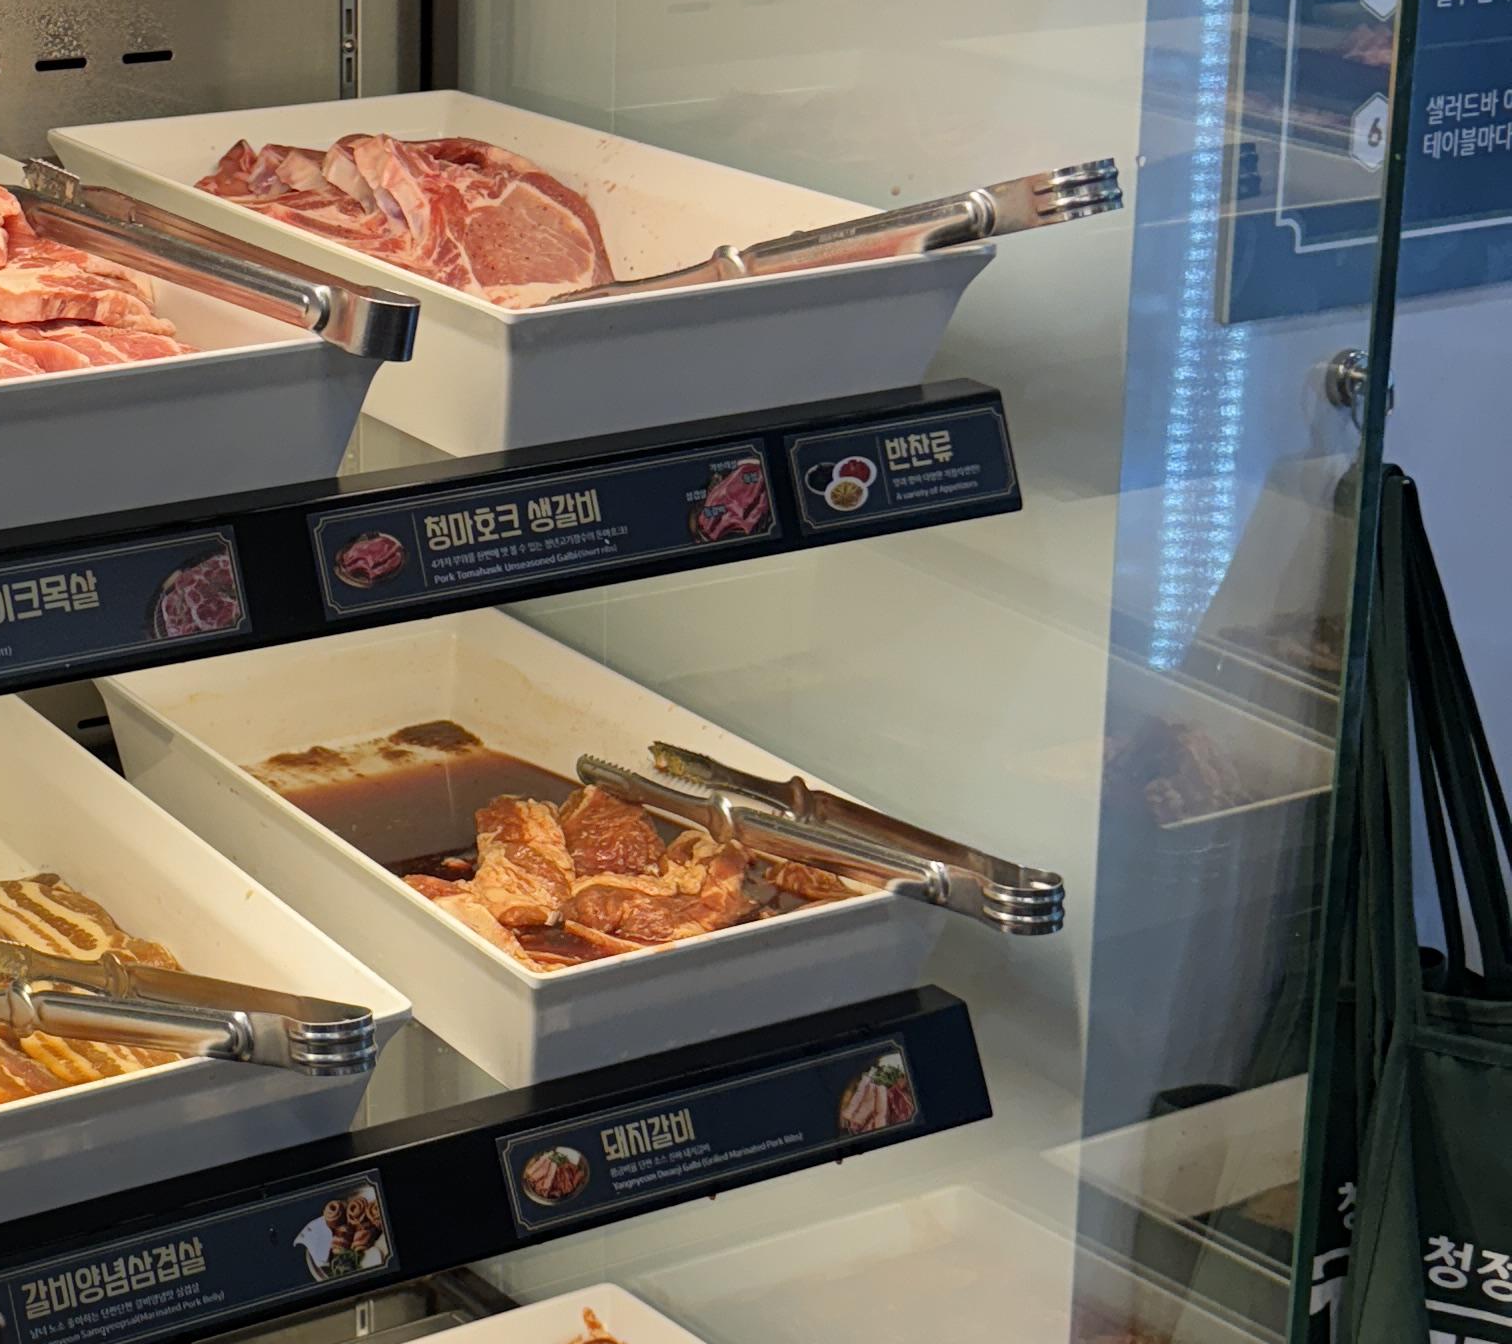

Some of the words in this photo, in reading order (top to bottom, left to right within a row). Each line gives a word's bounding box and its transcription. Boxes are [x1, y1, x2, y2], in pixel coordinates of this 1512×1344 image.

[1426, 90, 1498, 125] 샐러드바
[1368, 118, 1383, 147] 6
[885, 430, 953, 470] 반찬류
[424, 504, 522, 550] 청마호크
[528, 489, 601, 532] 생갈비
[434, 573, 455, 584] Pork
[457, 564, 503, 579] Tomahawk
[504, 554, 556, 571] Unseasoned
[601, 1108, 695, 1161] 돼지갈비
[21, 1237, 206, 1320] 갈비양념삼겹살
[182, 1298, 202, 1309] Pork
